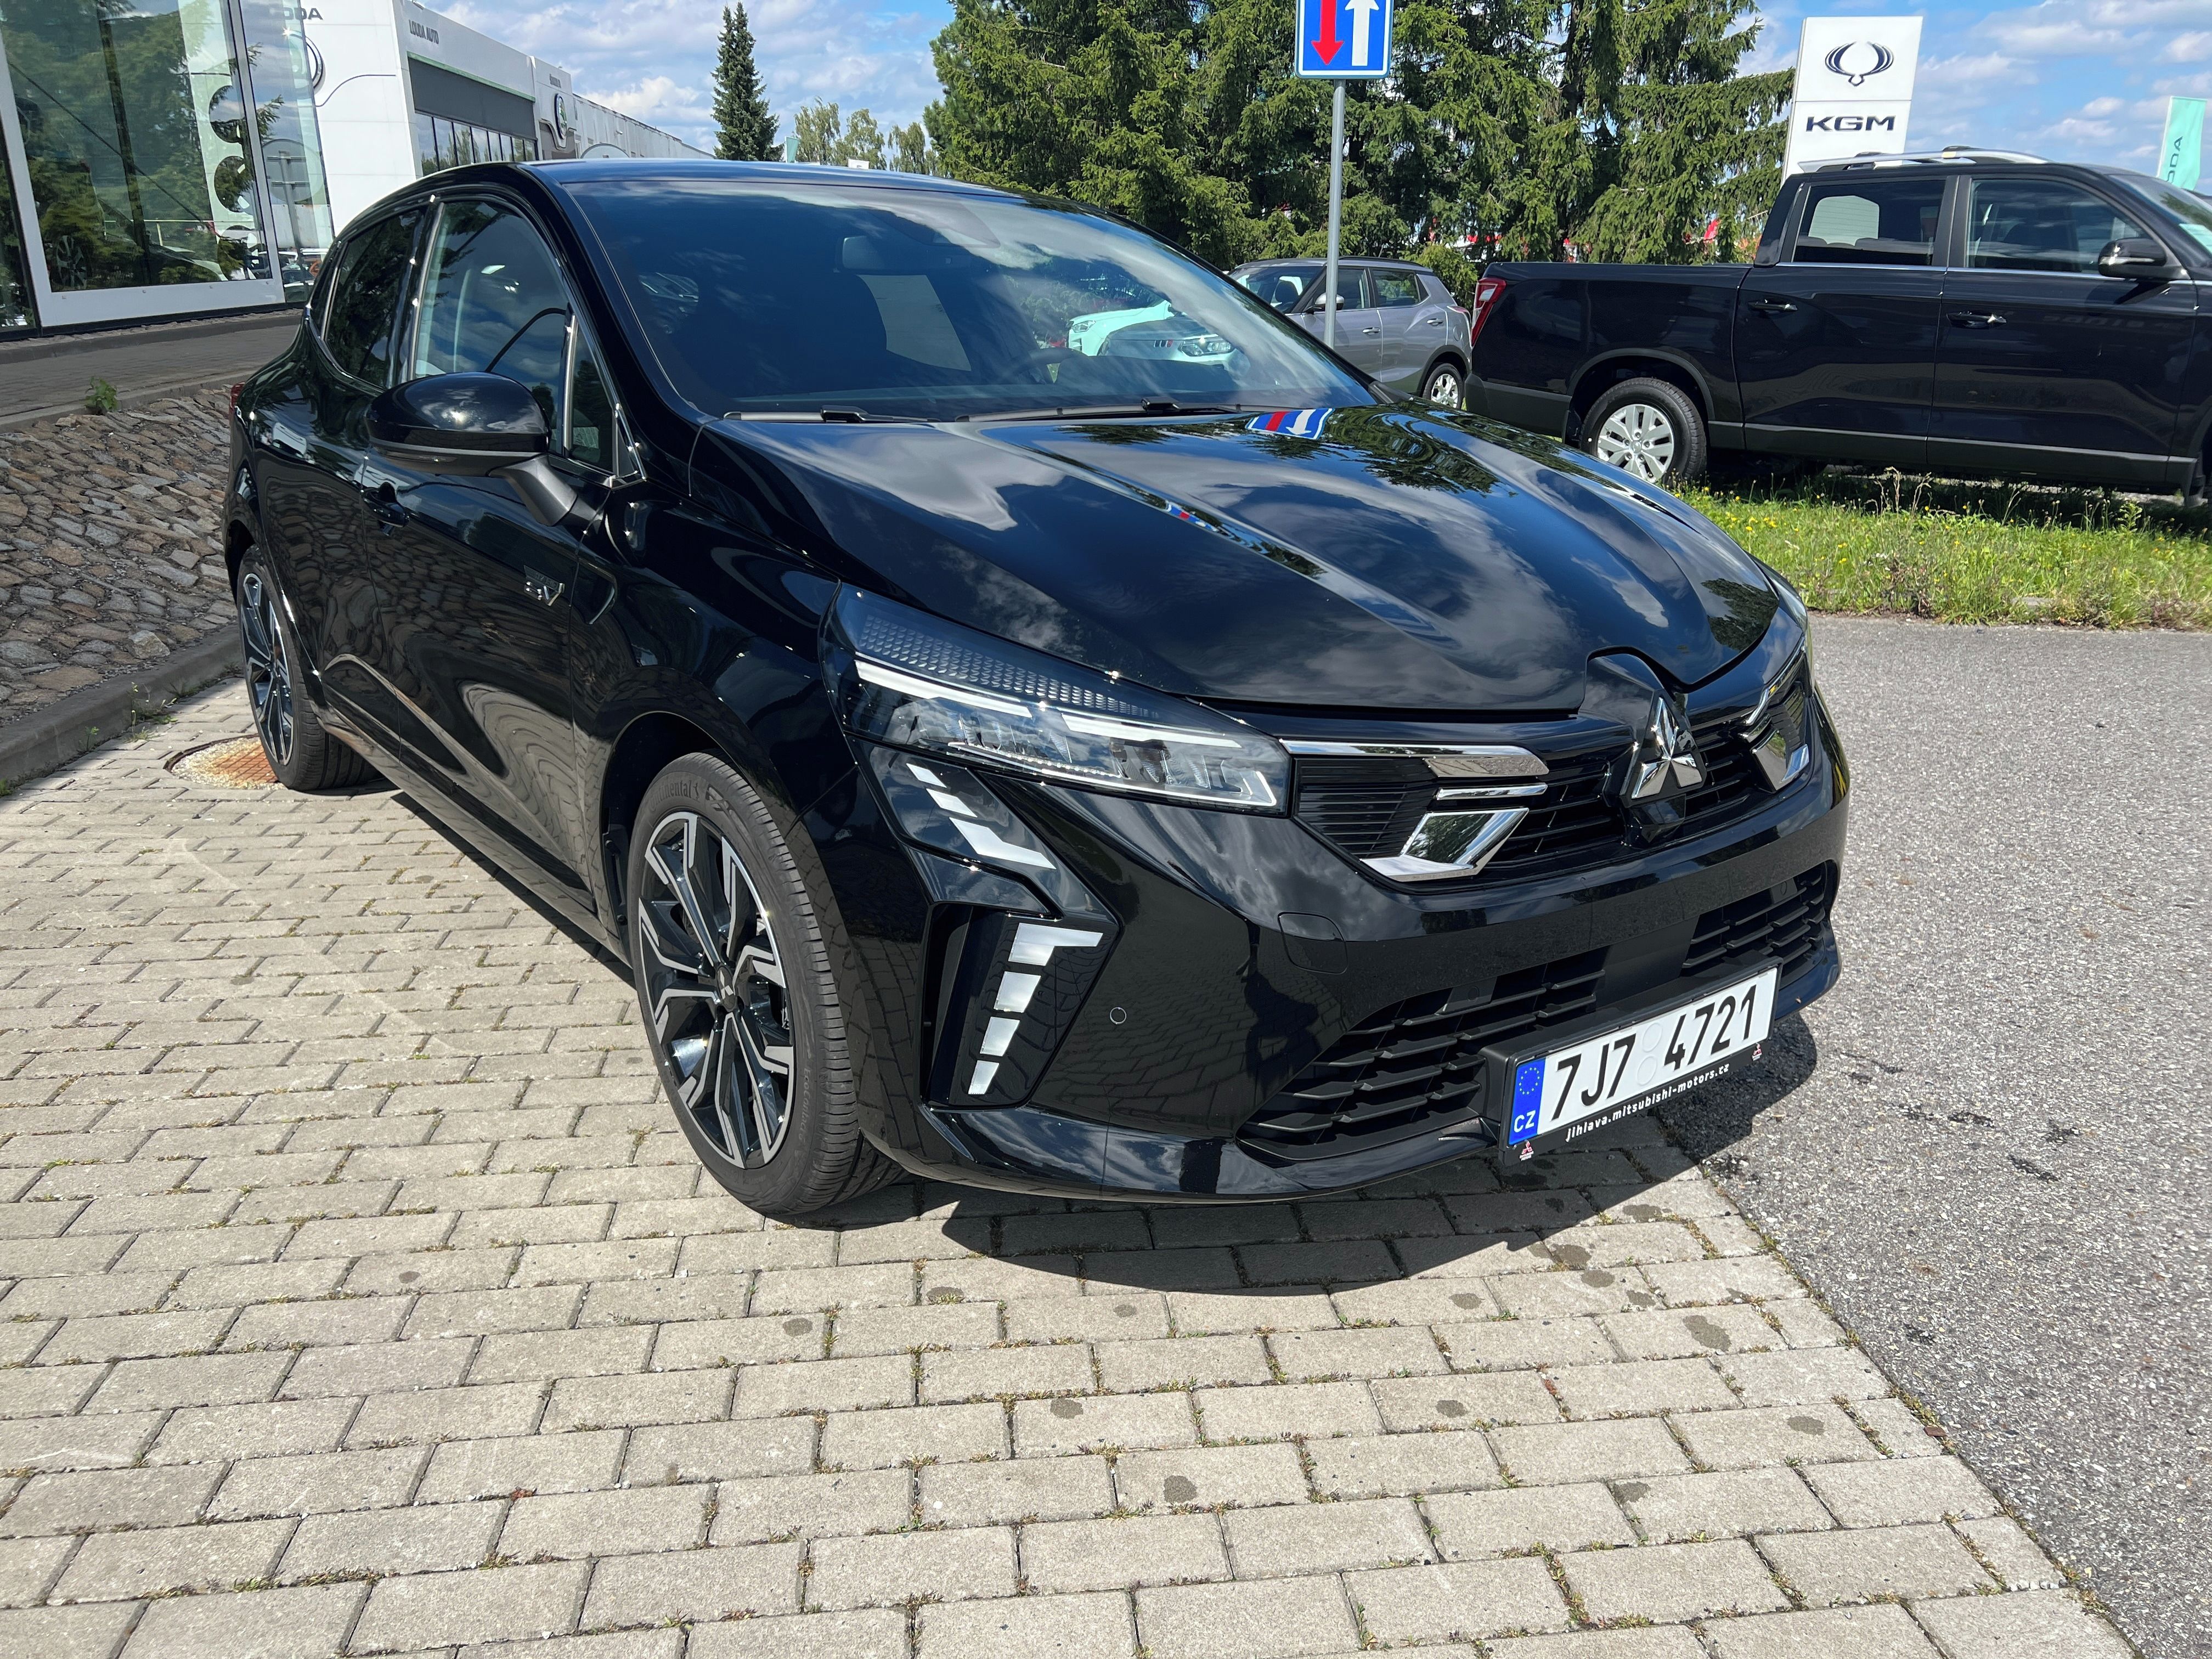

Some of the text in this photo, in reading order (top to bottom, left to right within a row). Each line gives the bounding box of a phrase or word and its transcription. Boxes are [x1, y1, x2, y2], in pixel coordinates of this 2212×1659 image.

[1805, 115, 1896, 132] KGM
[1551, 984, 1757, 1121] 7J7 4721
[1513, 1110, 1536, 1133] CZ
[1565, 1063, 1730, 1143] jihlava.mitsubishi-motors.cz
